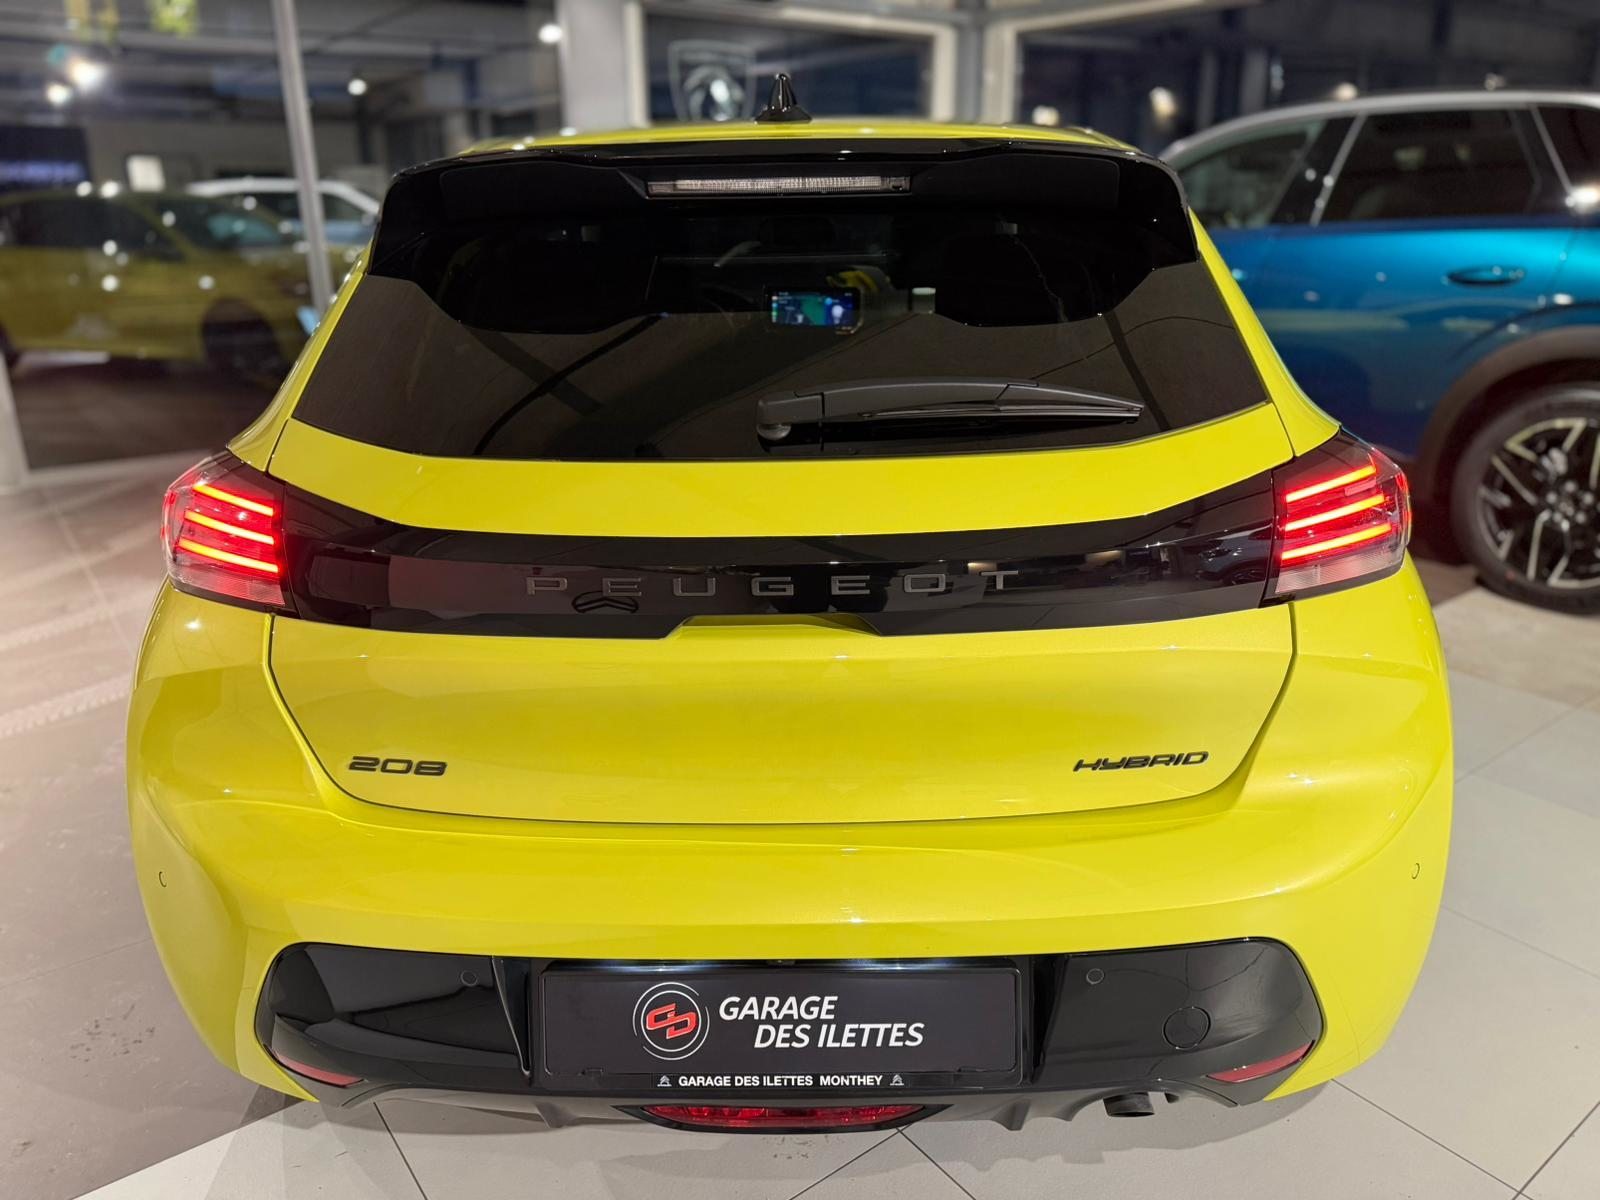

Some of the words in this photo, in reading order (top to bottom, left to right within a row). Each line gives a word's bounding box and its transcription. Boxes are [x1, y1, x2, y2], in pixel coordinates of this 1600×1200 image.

[526, 570, 1019, 597] PEUGEOT
[348, 755, 448, 777] 208
[1072, 751, 1209, 772] HYBRID
[719, 996, 838, 1021] GARAGE
[754, 1024, 811, 1048] DES
[817, 1022, 925, 1048] ILETTES
[678, 1075, 731, 1087] GARAGE
[734, 1075, 760, 1087] DES
[763, 1075, 813, 1086] ILETTES
[819, 1075, 883, 1086] MONTHEY
